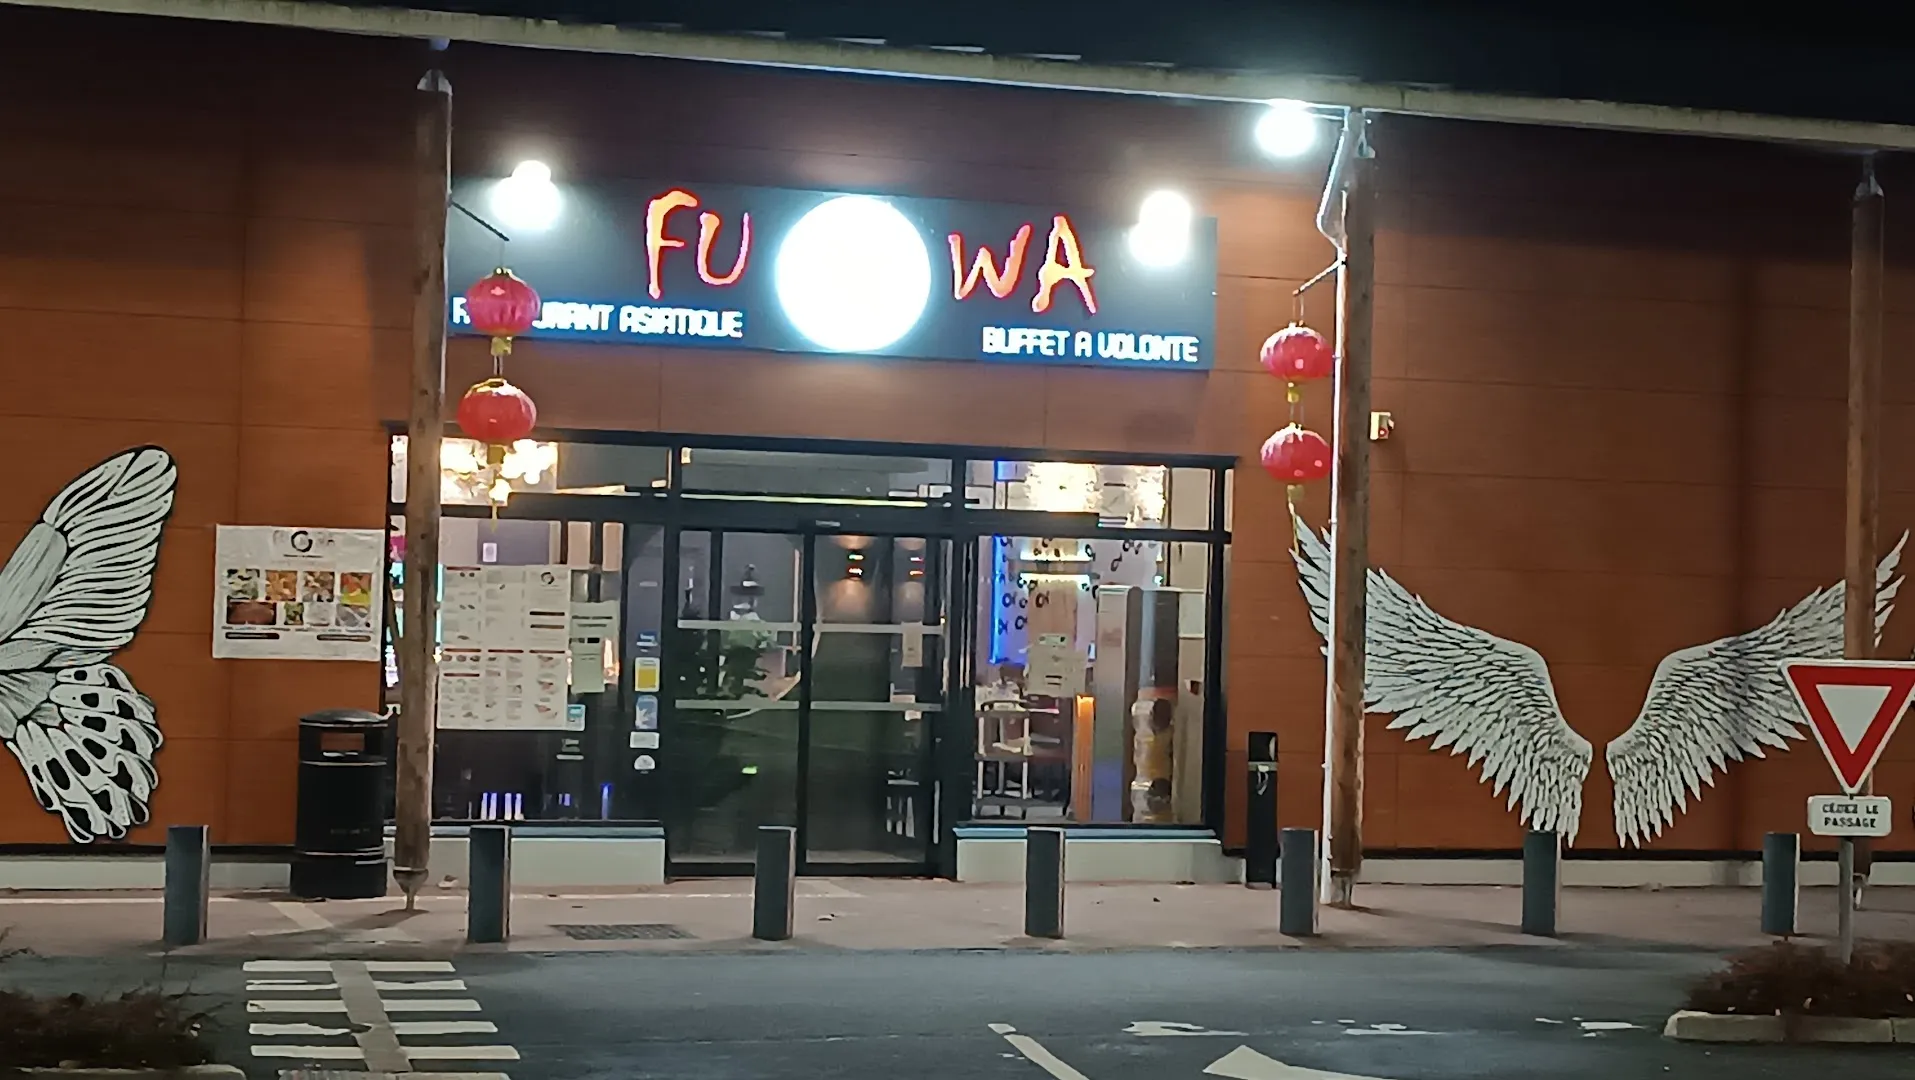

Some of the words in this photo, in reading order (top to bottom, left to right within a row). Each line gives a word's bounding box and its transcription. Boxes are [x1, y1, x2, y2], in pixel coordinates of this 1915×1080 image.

[646, 187, 751, 299] FU
[948, 213, 1097, 316] WA
[452, 296, 615, 331] RURANT
[619, 305, 743, 338] ASIATIQUE
[982, 326, 1071, 356] BUFFET
[1074, 330, 1092, 358] A
[1097, 331, 1199, 362] VOLONTE
[1824, 817, 1877, 828] PASSAGE
[1865, 805, 1879, 815] LE
